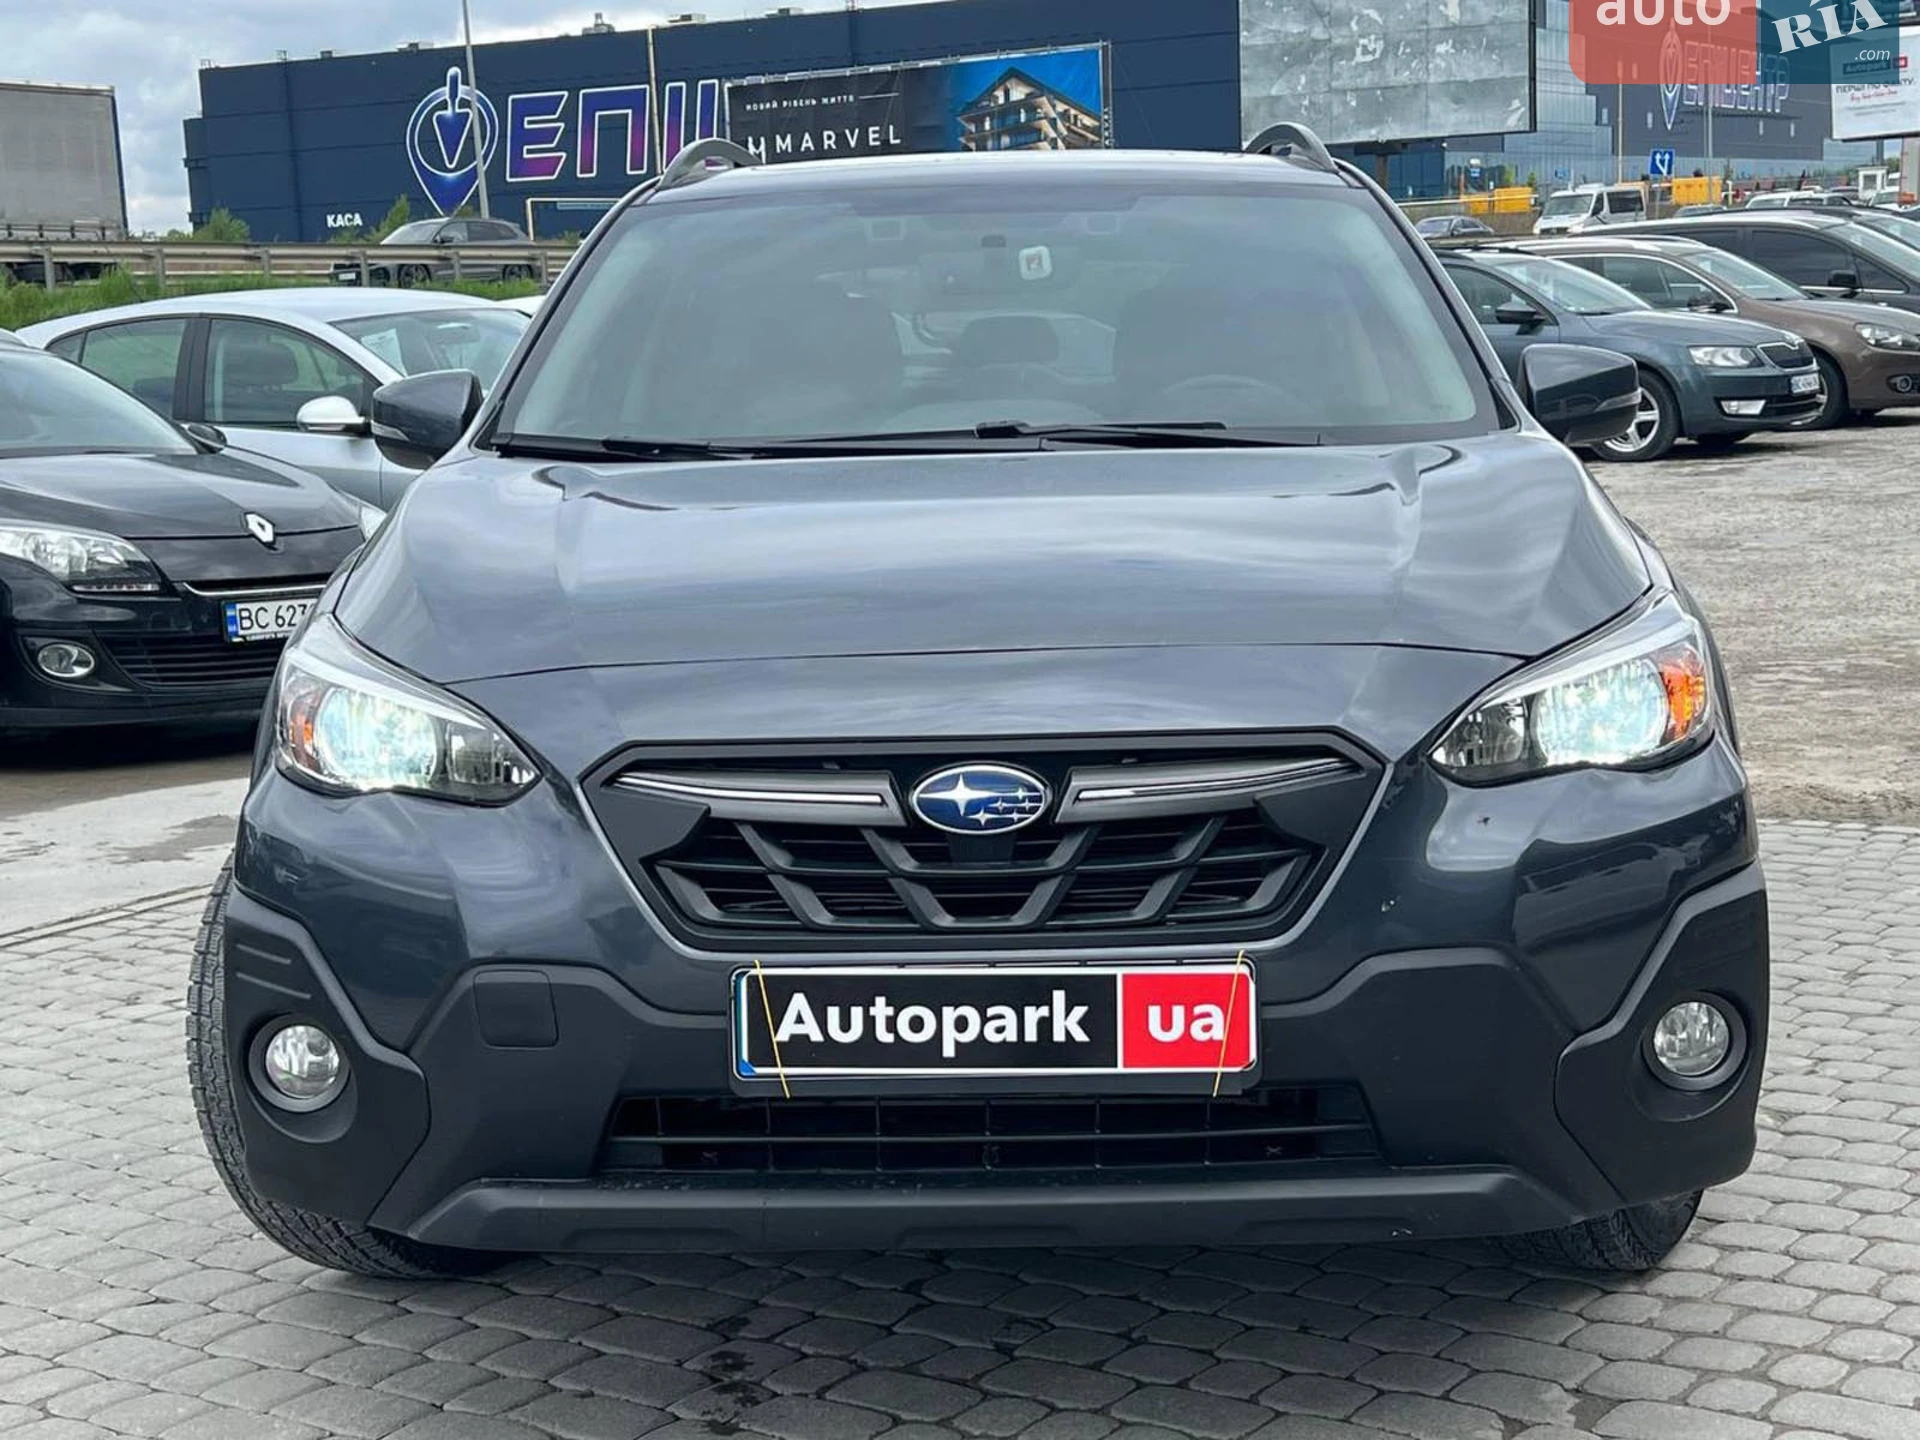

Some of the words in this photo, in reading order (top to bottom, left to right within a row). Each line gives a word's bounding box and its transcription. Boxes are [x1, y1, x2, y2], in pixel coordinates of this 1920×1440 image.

[775, 124, 902, 154] MARVEL
[327, 213, 363, 228] КАСА
[775, 989, 1090, 1059] Autopark
[1147, 1002, 1226, 1045] ua
